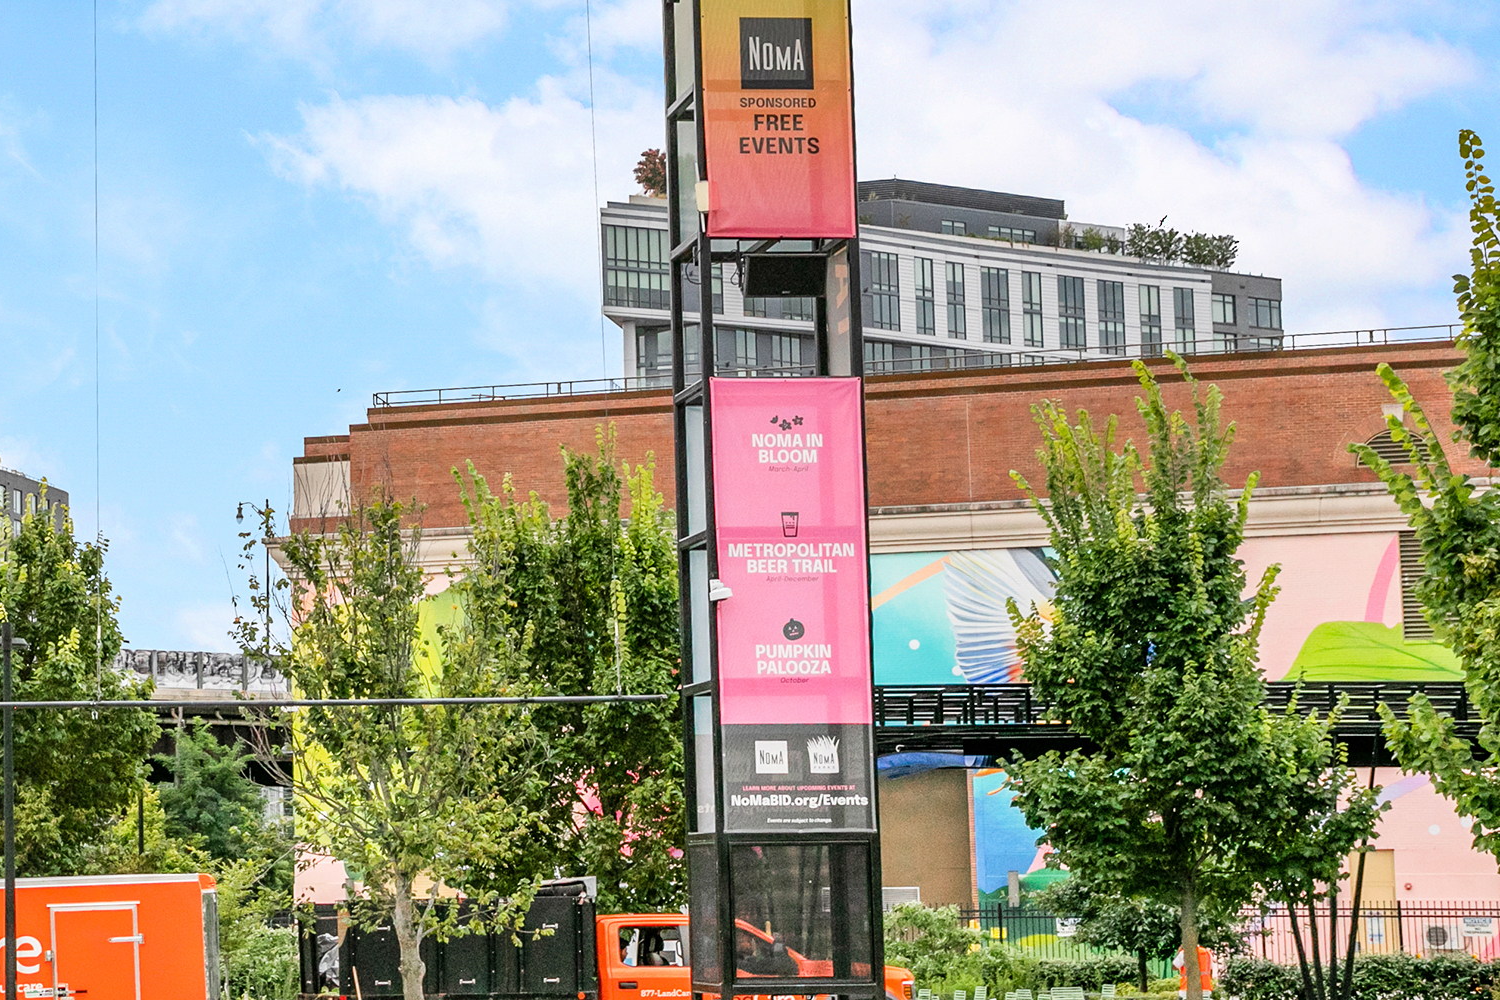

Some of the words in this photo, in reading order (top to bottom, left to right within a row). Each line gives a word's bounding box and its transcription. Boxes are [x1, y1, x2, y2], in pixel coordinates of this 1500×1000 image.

[739, 97, 817, 108] SPONSORED
[753, 114, 804, 131] FREE
[739, 137, 820, 154] EVENTS
[751, 433, 803, 448] NOMA
[806, 433, 823, 448] IN
[758, 449, 818, 464] BLOOM
[728, 543, 855, 558] METROPOLITAN
[747, 559, 788, 574] BEER
[791, 559, 838, 574] TRAIL
[755, 644, 832, 659] PUMPKIN
[756, 660, 832, 675] PALOOZA
[731, 794, 869, 809] NoMaBID.org/Events
